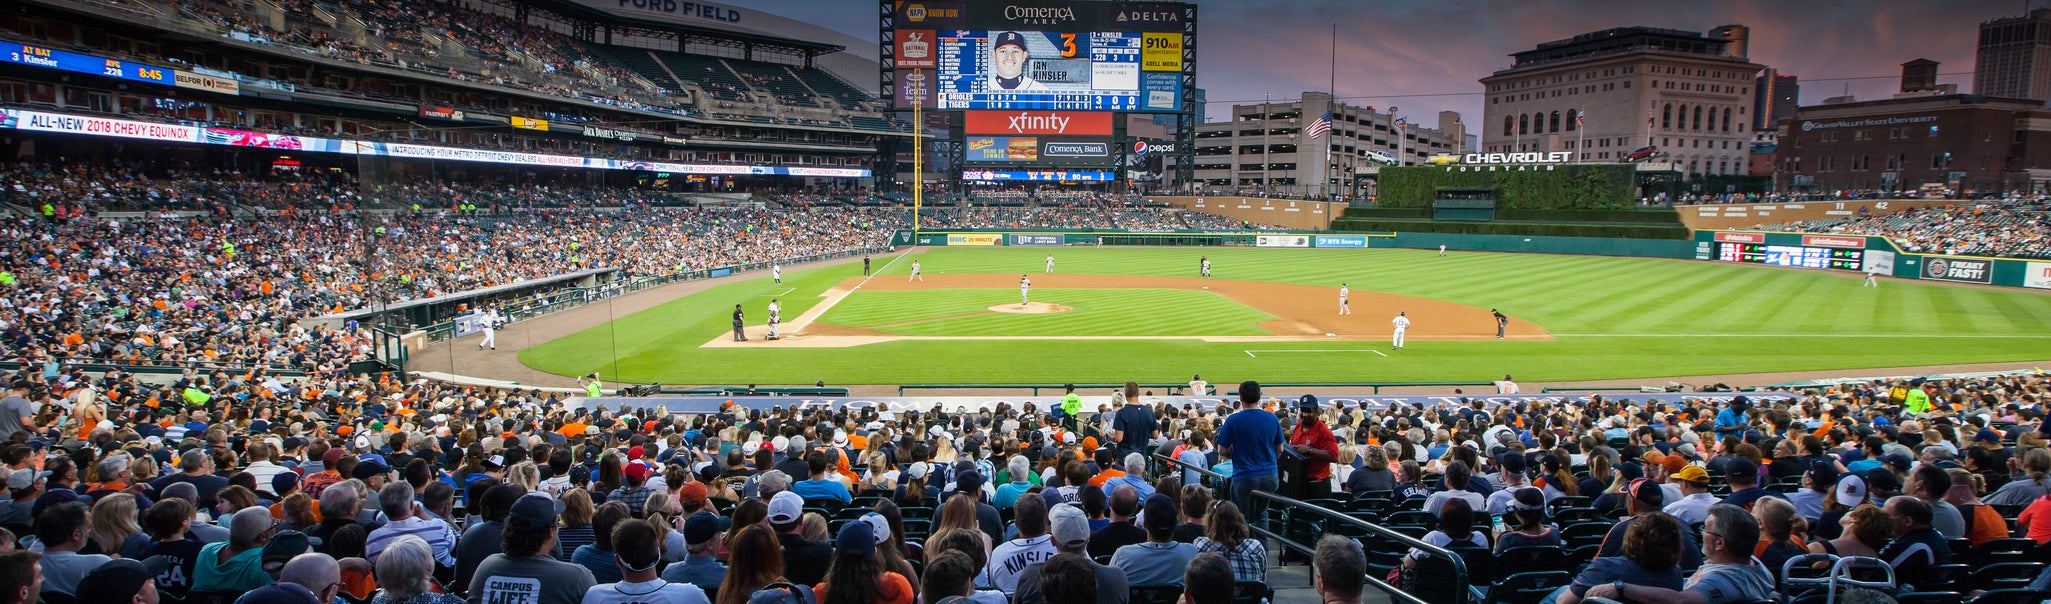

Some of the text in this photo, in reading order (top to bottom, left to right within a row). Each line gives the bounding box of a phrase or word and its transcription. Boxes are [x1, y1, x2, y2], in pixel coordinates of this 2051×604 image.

[680, 2, 741, 23] FIELD
[909, 8, 959, 17] NAPA KNOW HOW
[1132, 12, 1178, 21] DELTA
[1061, 33, 1077, 57] 3
[1146, 38, 1168, 48] 910
[23, 46, 51, 57] AT BAT
[11, 52, 58, 67] 3 Kinsler
[1033, 61, 1047, 70] IAN
[139, 67, 162, 80] 8:45
[1033, 71, 1067, 80] KINSLER
[176, 74, 201, 85] BELFOR
[948, 93, 973, 101] ORIOLES
[1096, 96, 1135, 105] 3 0 0
[948, 101, 970, 109] TIGERS
[1008, 112, 1070, 133] xfinity
[1888, 116, 1938, 125] UNIVERSITY
[31, 114, 189, 139] ALL-NEW 2018 CHEVY EQUINOX
[583, 126, 614, 139] JACK DANIEL'S
[1085, 145, 1103, 153] Bank
[1148, 143, 1174, 153] pepsi
[392, 145, 436, 156] INTRODUCING
[437, 148, 452, 157] YOUR
[454, 150, 473, 158] METRO
[474, 151, 496, 159] DETROIT
[497, 153, 514, 161] CHEVY
[515, 154, 537, 162] DEALERS
[1466, 151, 1573, 164] CHEVROLET
[1950, 261, 1986, 270] FREAKY
[1948, 269, 1985, 279] FAST!
[491, 580, 532, 592] CAMPUS
[489, 590, 530, 604] LIFE
